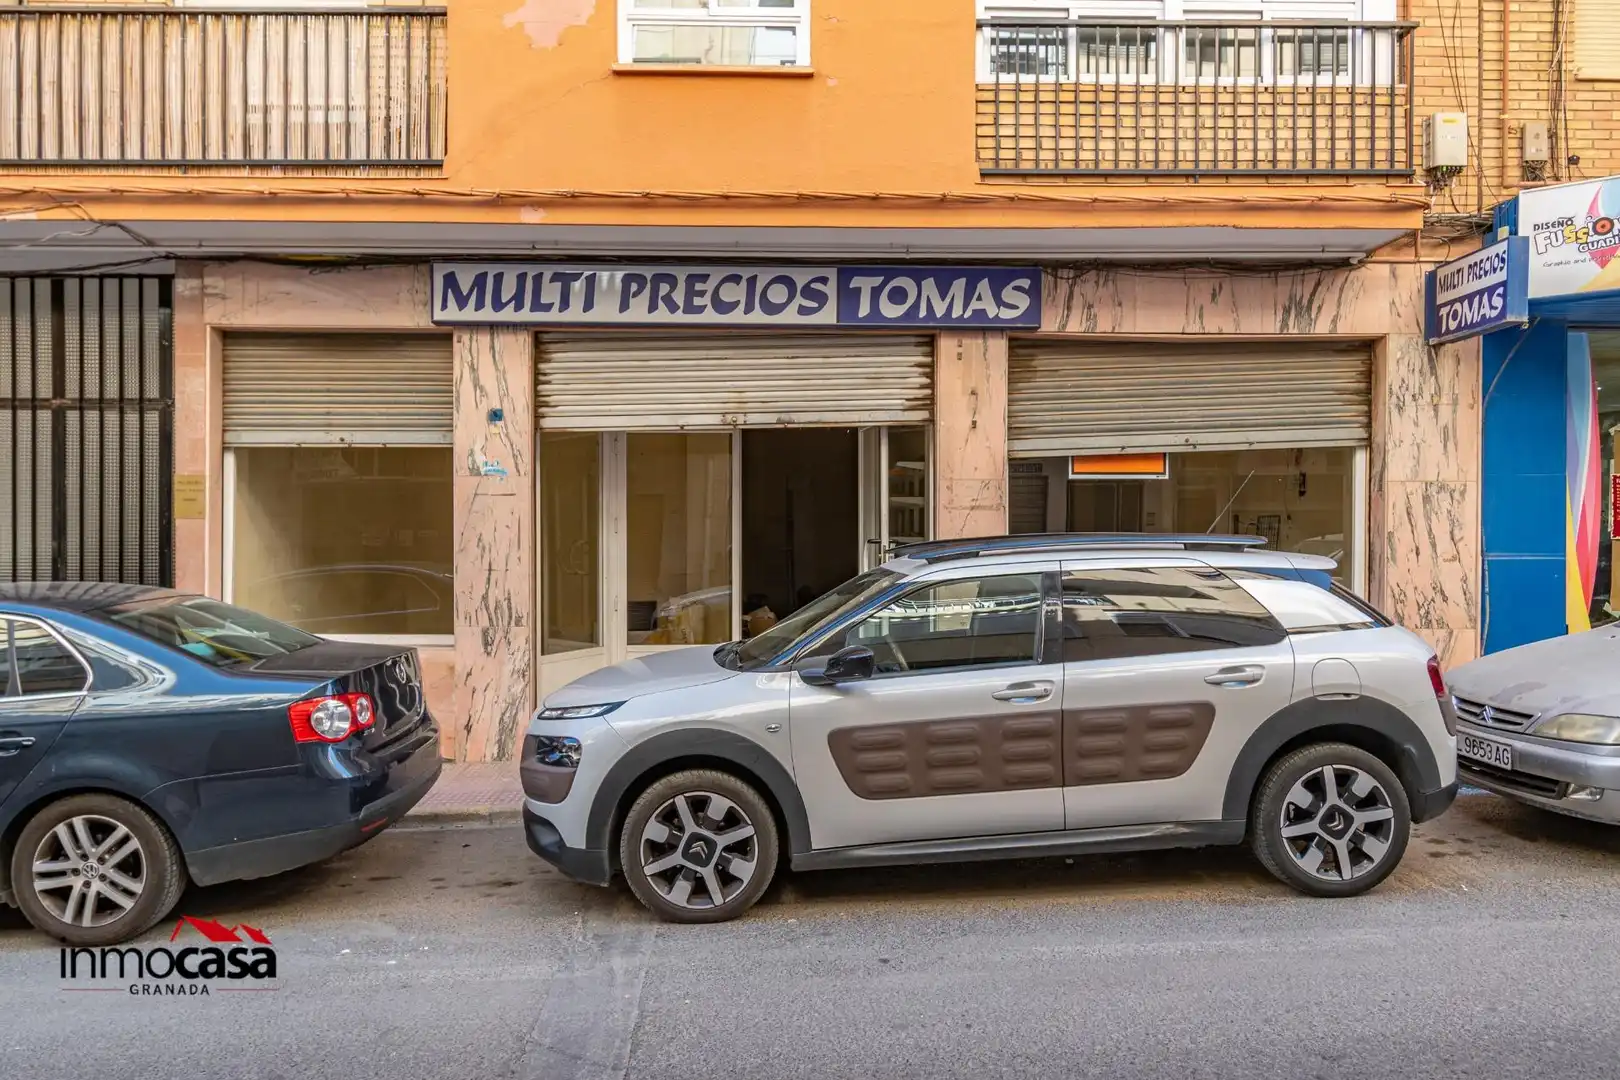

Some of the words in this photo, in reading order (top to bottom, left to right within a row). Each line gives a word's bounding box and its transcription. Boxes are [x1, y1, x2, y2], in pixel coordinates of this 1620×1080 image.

[440, 270, 598, 313] MULTI
[618, 272, 830, 317] PRECIOS
[850, 276, 1031, 319] TOMAS
[1438, 269, 1464, 295] MULTI
[1467, 250, 1506, 284] PRECIOS
[1439, 286, 1505, 334] TOMAS
[1464, 736, 1493, 761] 9653
[1495, 745, 1510, 766] AG
